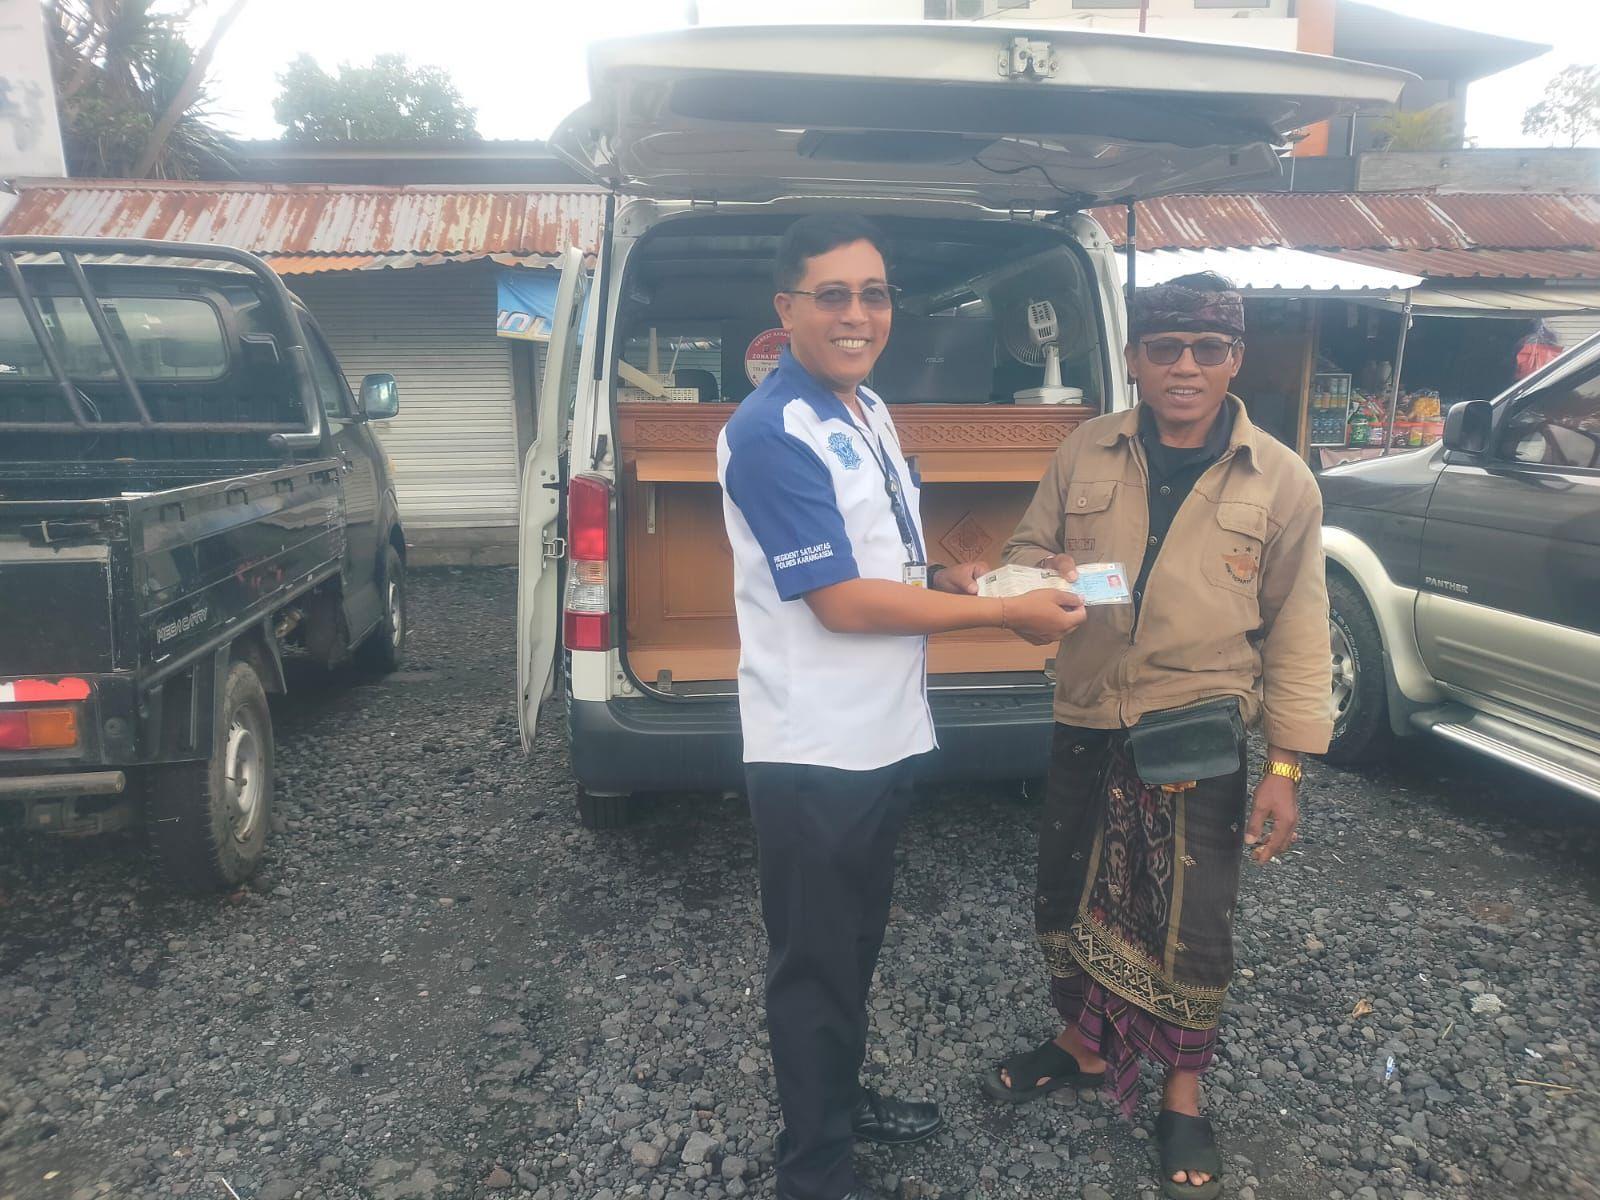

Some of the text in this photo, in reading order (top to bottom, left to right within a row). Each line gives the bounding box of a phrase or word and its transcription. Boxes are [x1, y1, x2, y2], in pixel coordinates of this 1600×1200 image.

[800, 542, 831, 556] SATLANTAS
[775, 549, 834, 571] POLRES KARANGASEM
[1425, 576, 1469, 594] PANTHER
